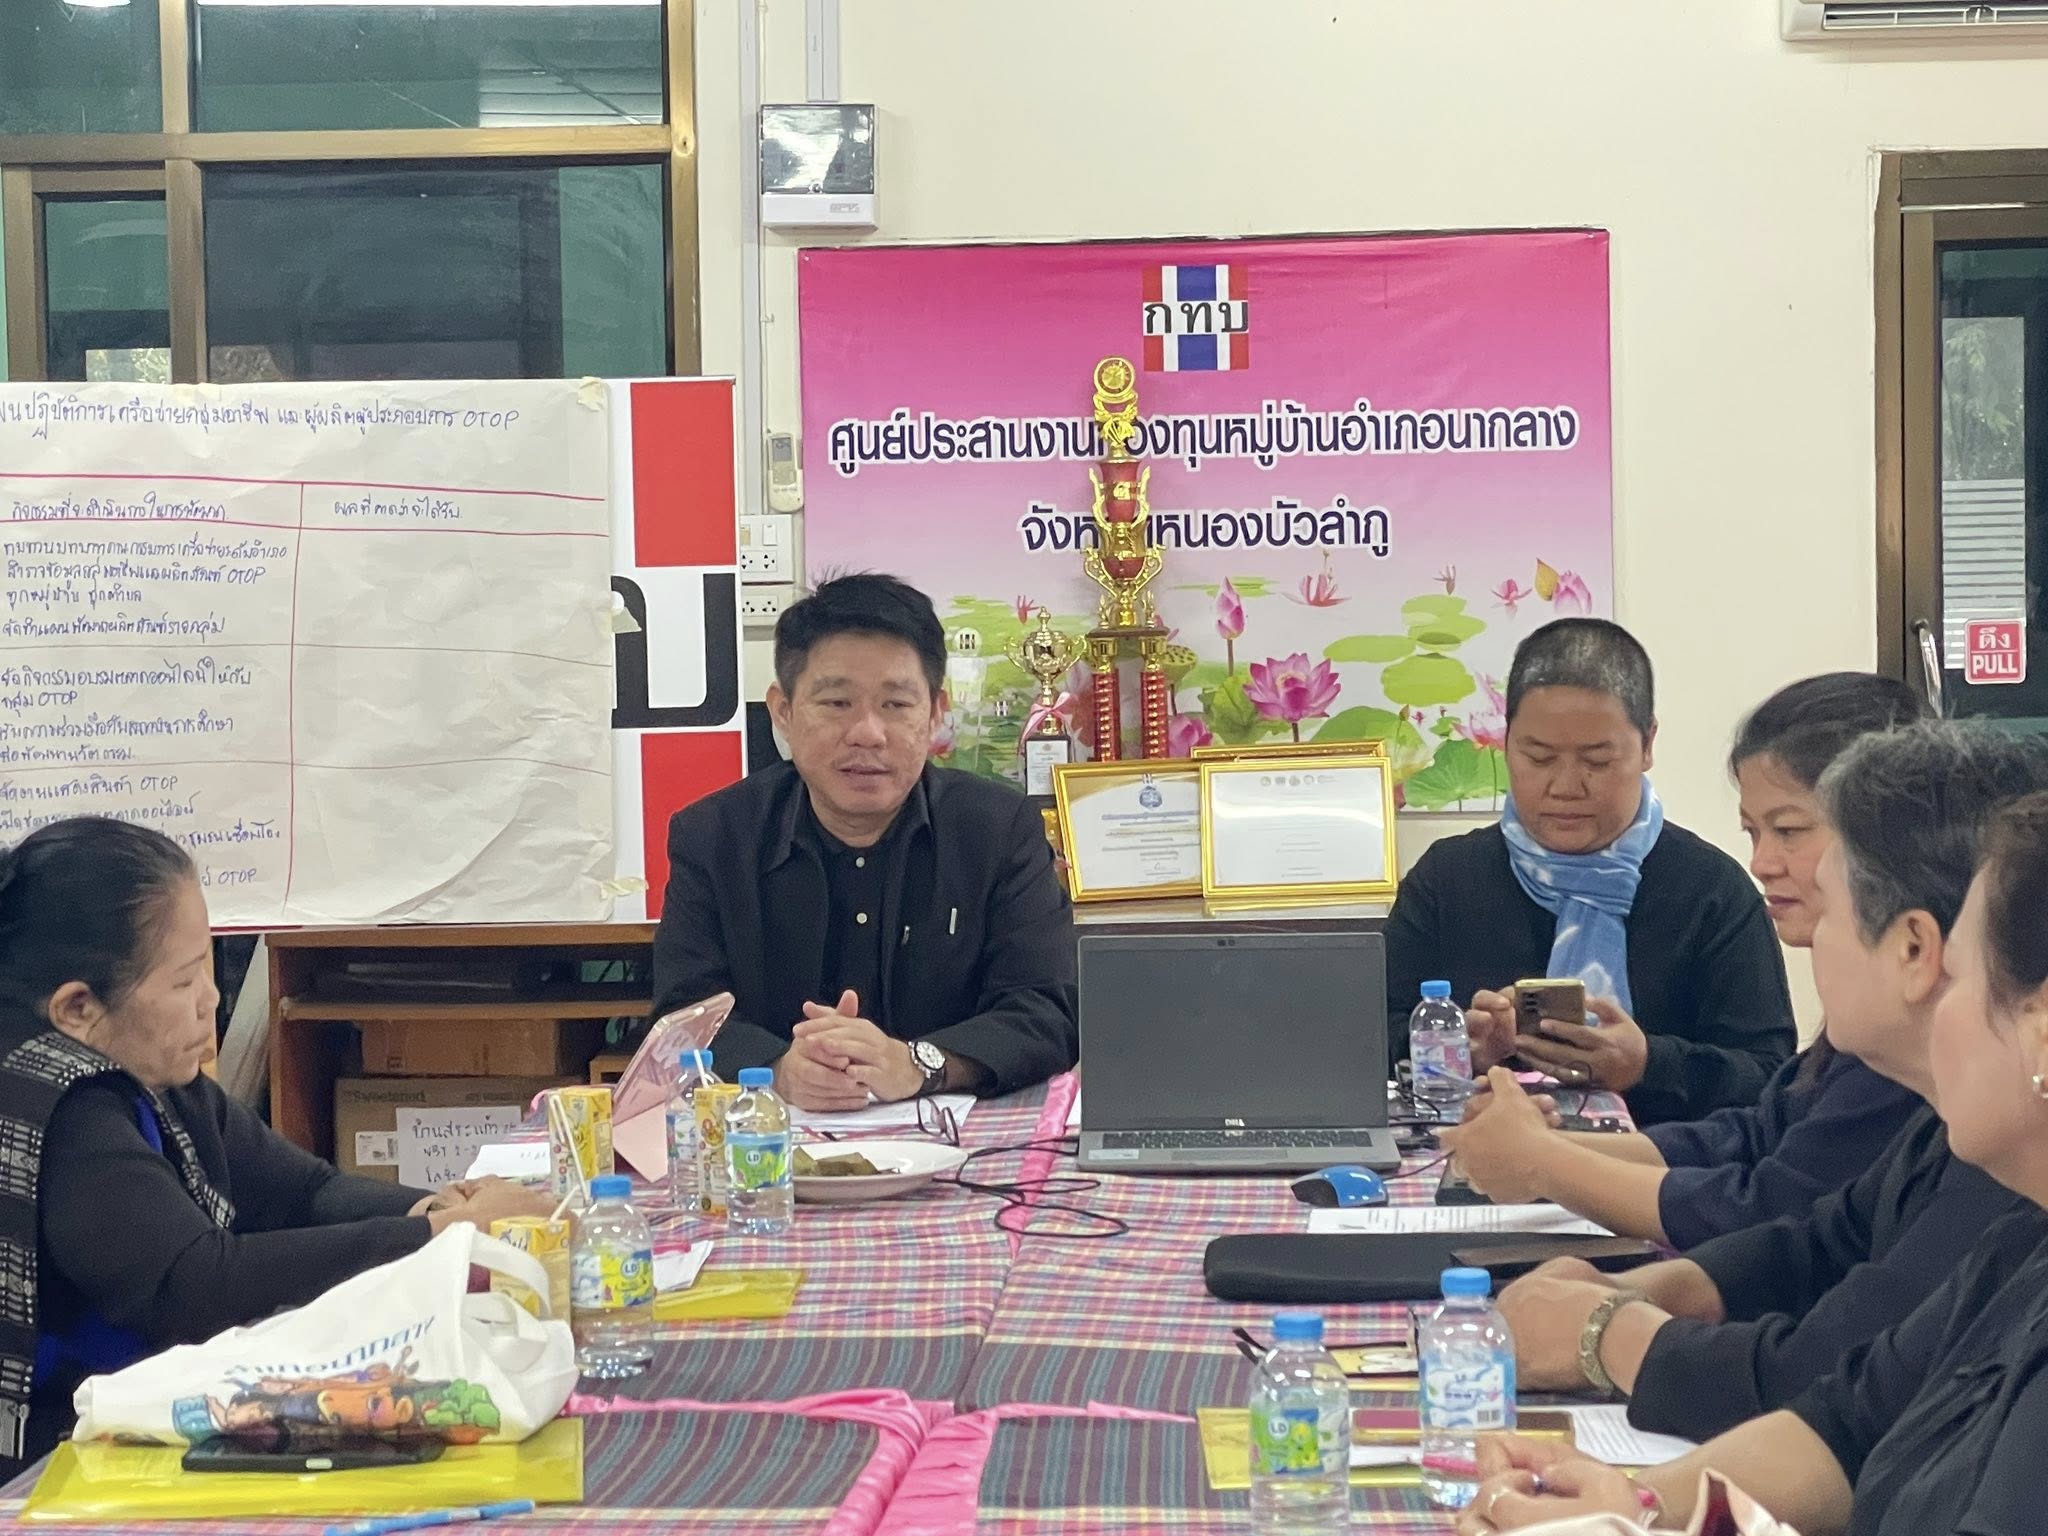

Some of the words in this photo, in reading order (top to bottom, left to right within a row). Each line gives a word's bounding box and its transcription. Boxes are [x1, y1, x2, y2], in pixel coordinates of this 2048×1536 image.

[1144, 302, 1248, 333] กทบ
[463, 411, 520, 430] OTOP
[831, 405, 1579, 473] ศูนย์ประสานงานองทุนหมู่บ้านอำเภอนากลาง
[1021, 498, 1389, 557] จังหหนองบัวลำภู
[227, 567, 266, 585] OTOP
[1978, 626, 2010, 649] ดึง
[1972, 653, 2018, 675] PULL
[38, 691, 78, 706] OTOP
[140, 776, 178, 791] OTOP
[218, 868, 257, 885] OTOP
